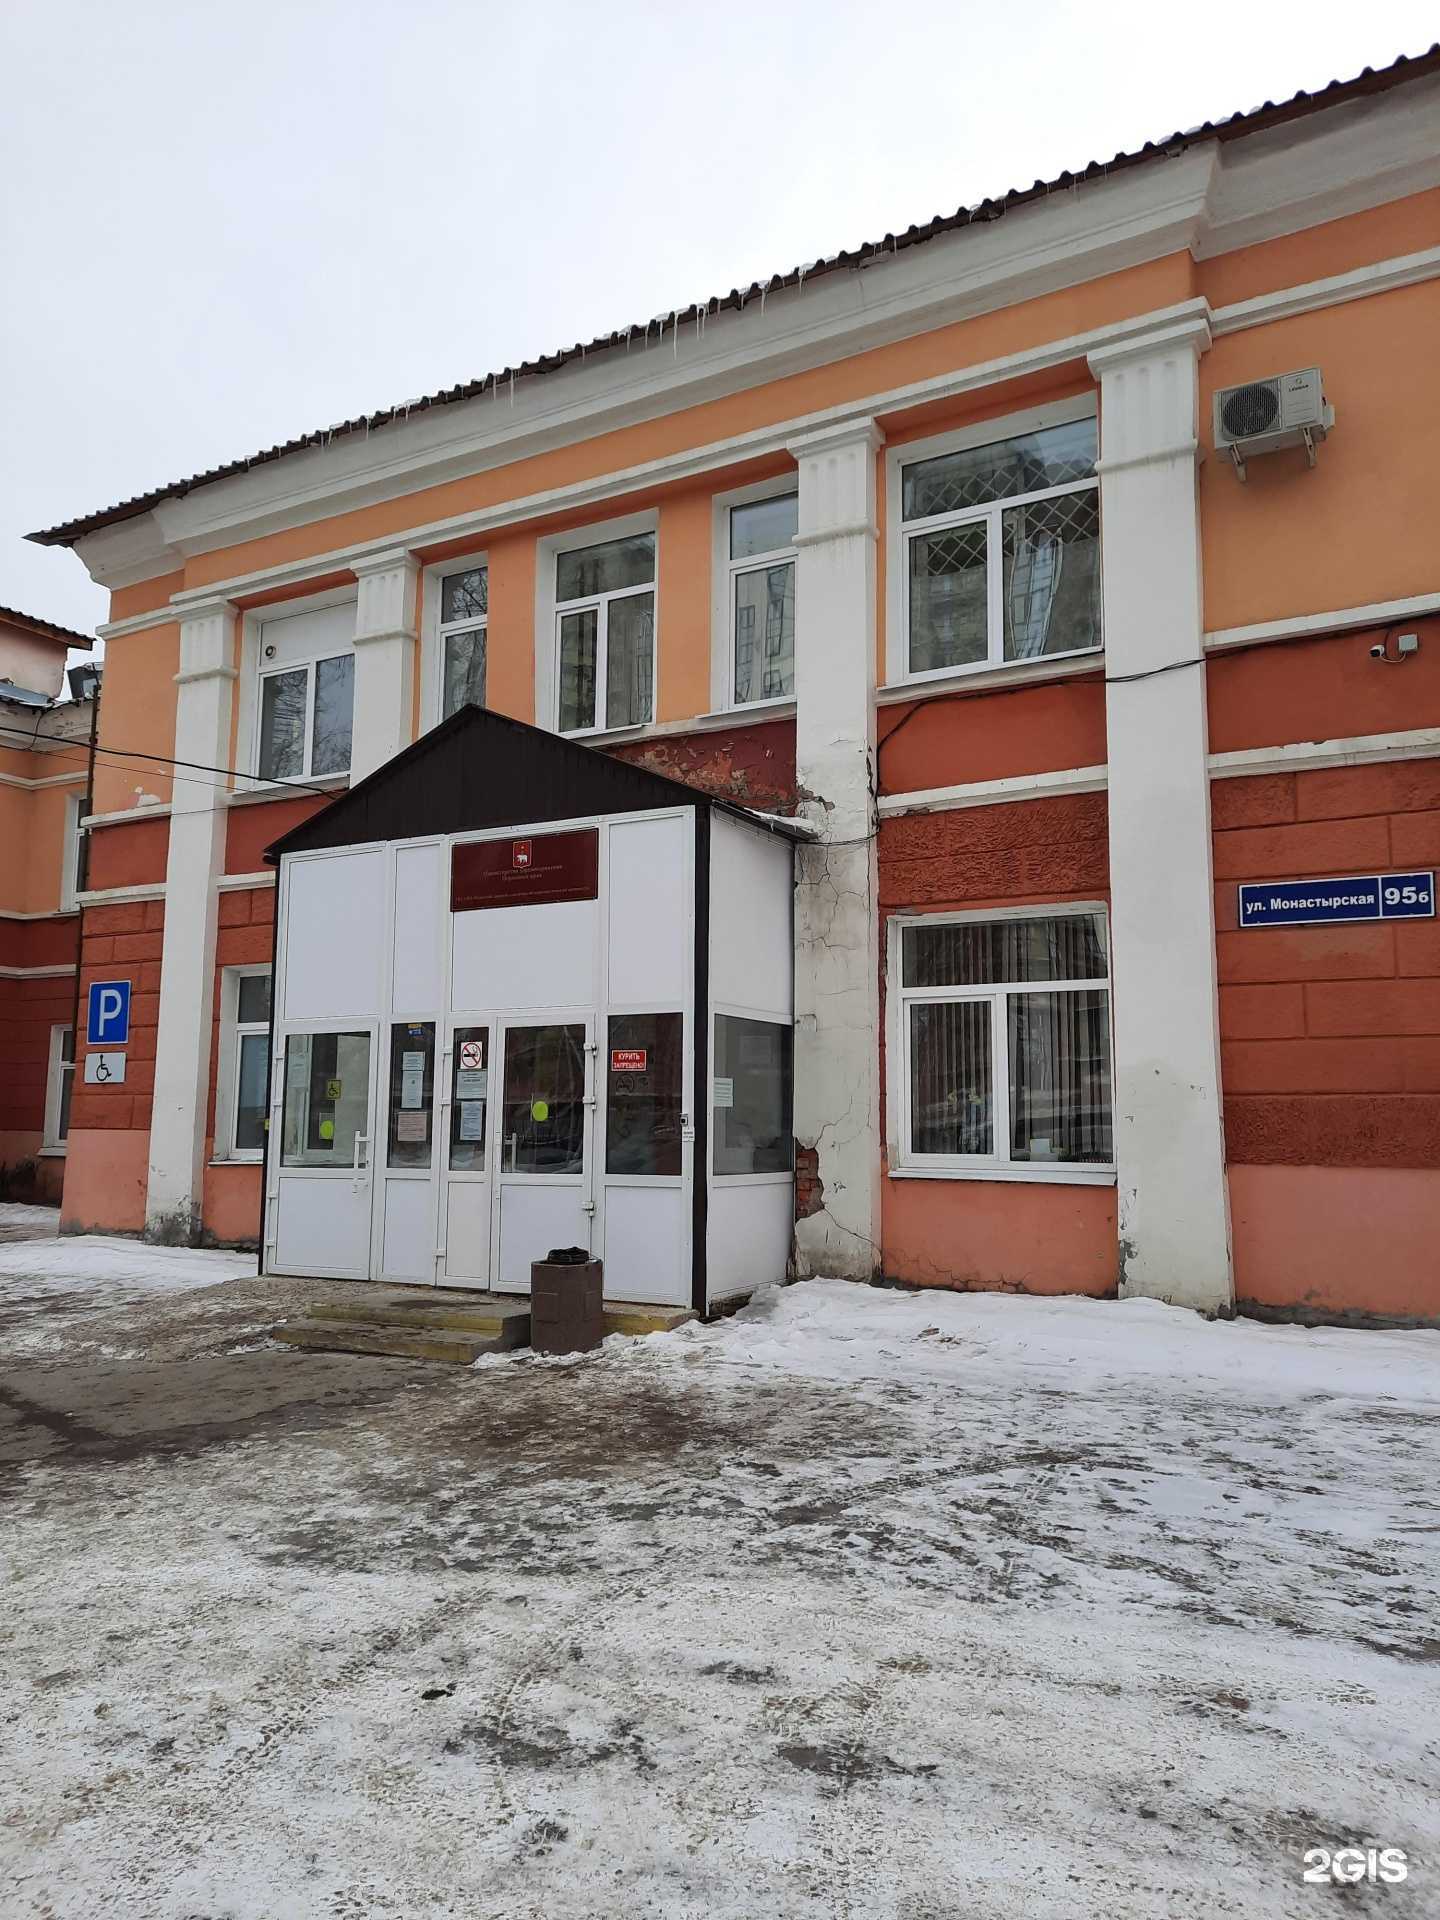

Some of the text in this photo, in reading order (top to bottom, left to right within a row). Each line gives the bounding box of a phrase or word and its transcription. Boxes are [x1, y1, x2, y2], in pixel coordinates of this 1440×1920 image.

[1246, 886, 1429, 914] ул. Монастырская 95б
[98, 989, 122, 1037] P
